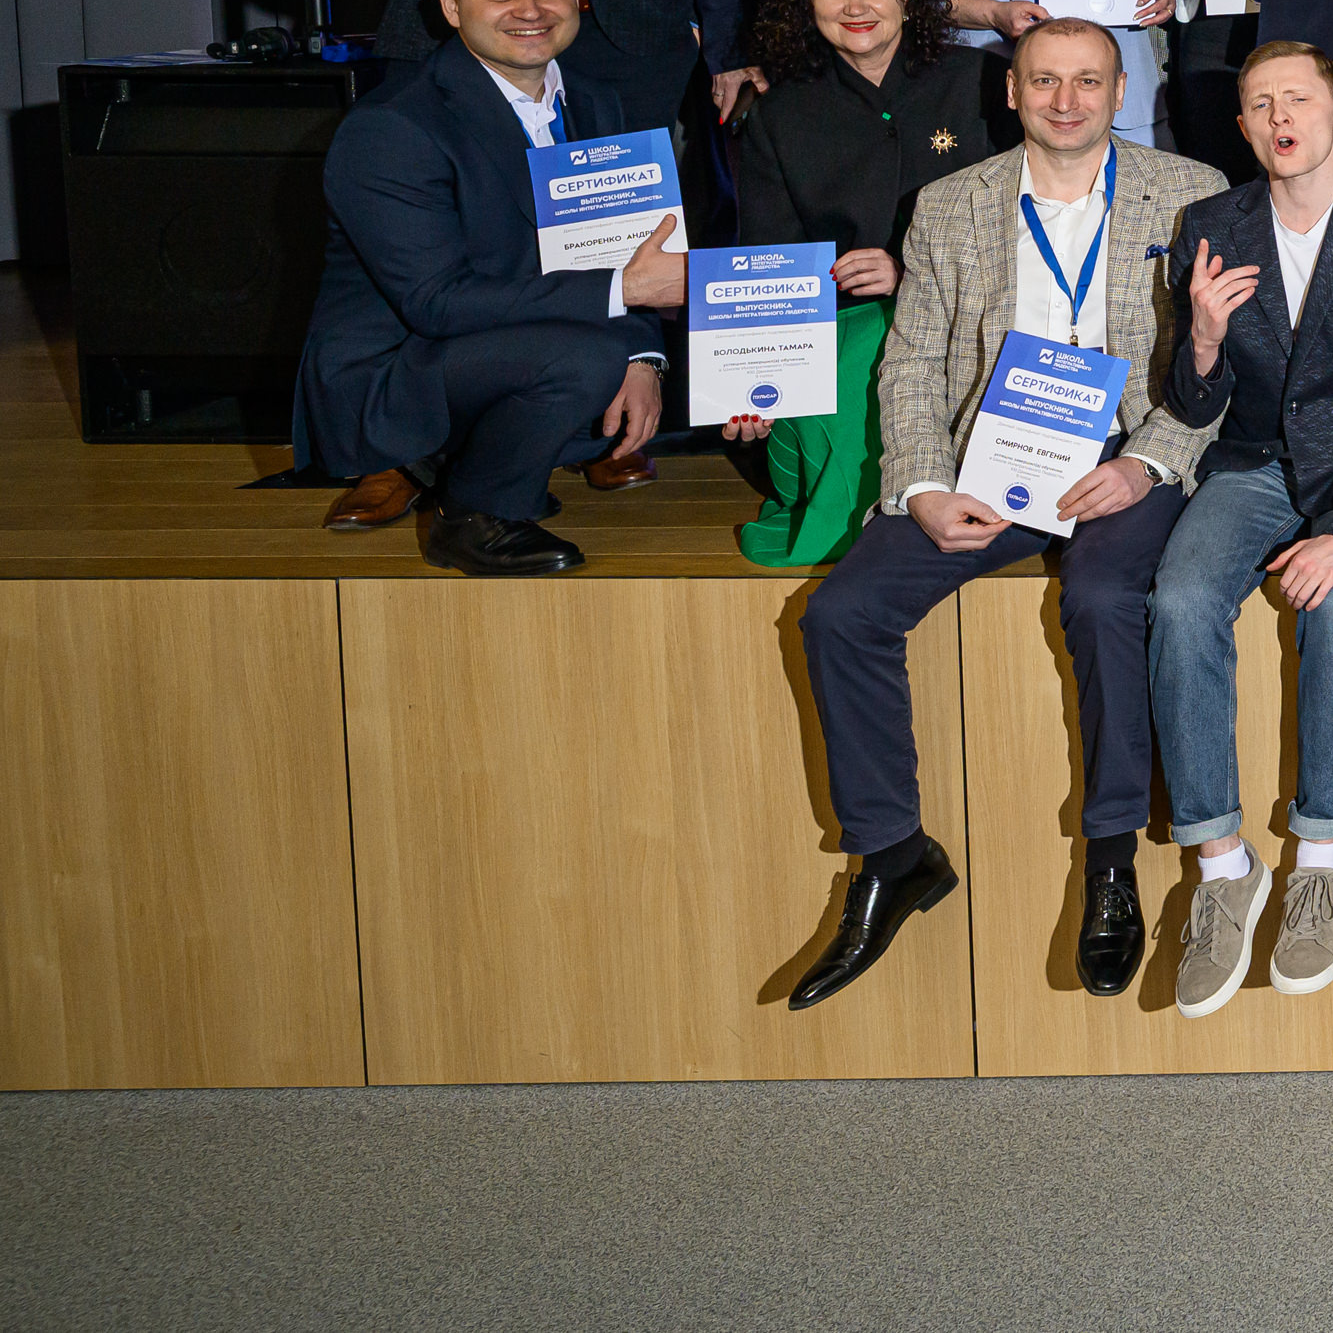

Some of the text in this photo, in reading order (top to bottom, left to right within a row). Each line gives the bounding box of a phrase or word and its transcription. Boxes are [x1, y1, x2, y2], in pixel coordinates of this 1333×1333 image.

[587, 144, 621, 154] ШКОЛА
[556, 169, 655, 194] СЕРТИФИКАТ
[580, 192, 637, 205] ВЫПУСКНИКА
[564, 229, 657, 250] БРАКОРЕНКО АНДРЕ
[750, 253, 785, 261] ШКОЛА
[713, 282, 814, 298] СЕРТИФИКАТ
[735, 302, 792, 312] ВЫПУСКНИКА
[708, 313, 732, 321] ШКОЛЫ
[733, 309, 783, 319] ИНТЕГРАТИВНОГО
[714, 343, 814, 357] ВОЛОДЬКИНА ТАМАРА
[1056, 351, 1085, 365] ШКОЛА
[1012, 374, 1101, 406] СЕРТИФИКАТ
[1024, 397, 1074, 417] ВЫПУСКНИКА
[995, 437, 1072, 463] СМИРНОВ ЕВГЕНИЙ
